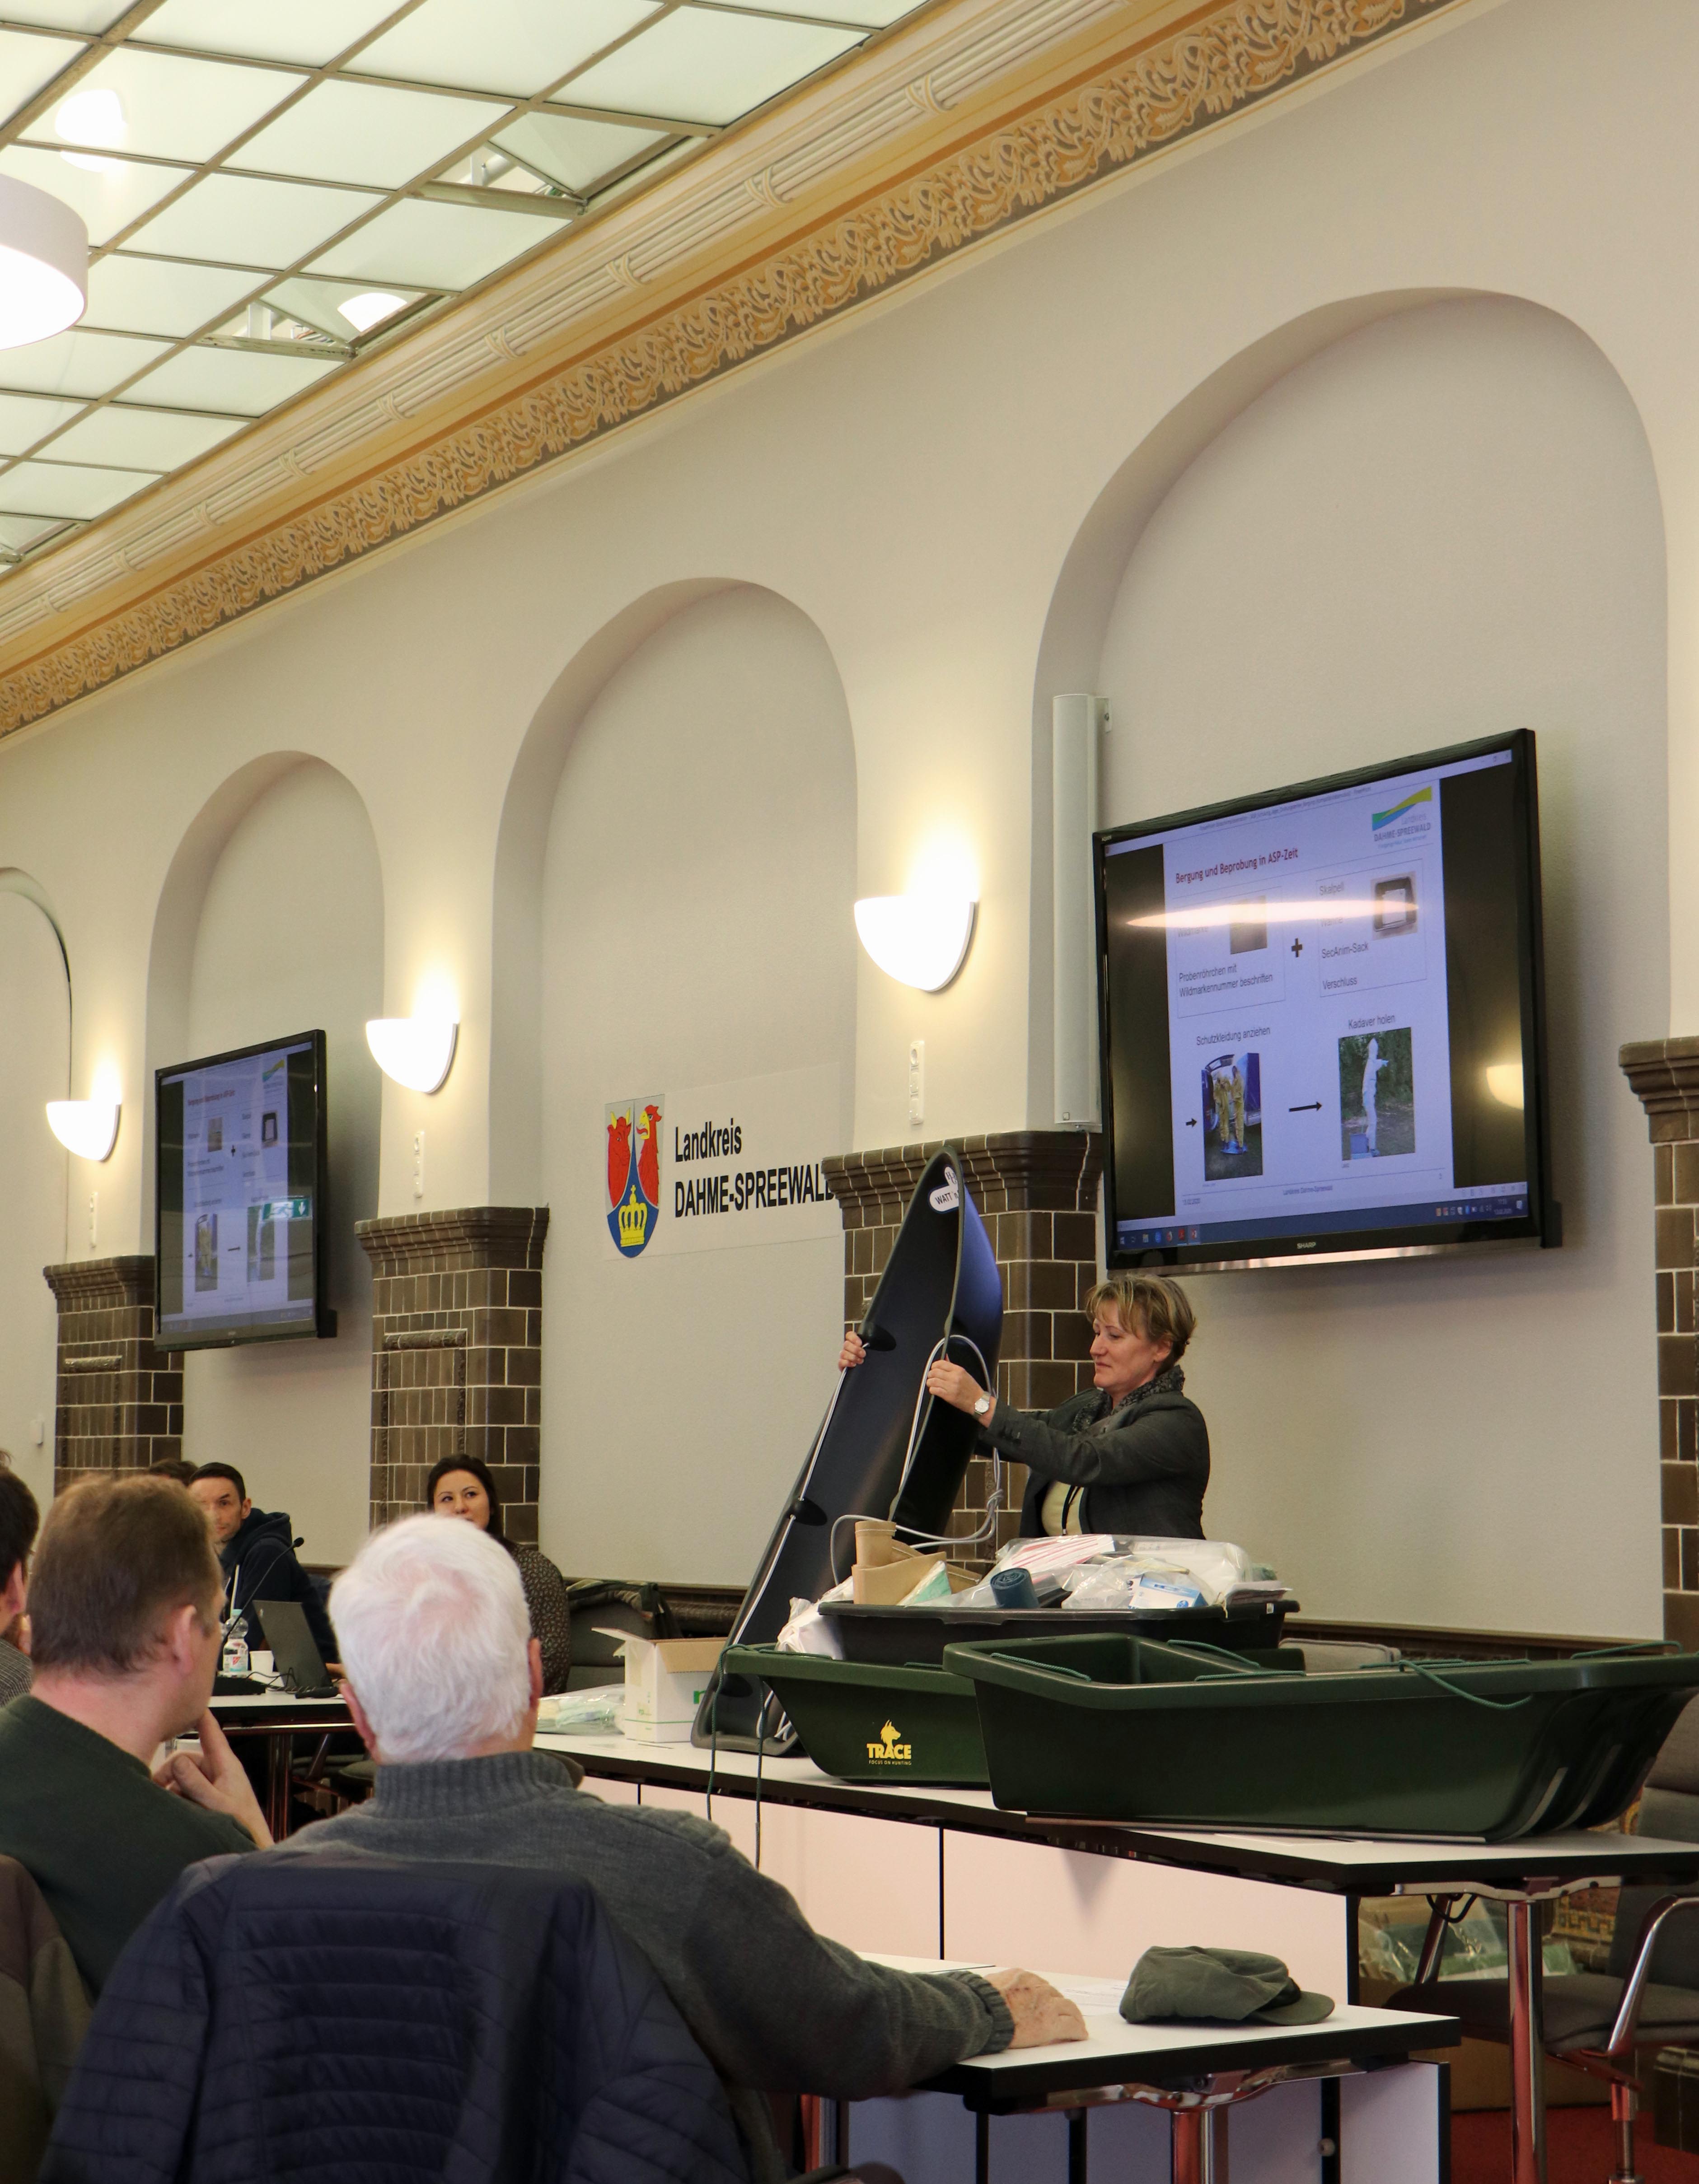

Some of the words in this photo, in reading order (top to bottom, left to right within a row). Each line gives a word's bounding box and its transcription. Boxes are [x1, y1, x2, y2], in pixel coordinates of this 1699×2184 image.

[1374, 822, 1431, 841] DAHME-SPREEWALD
[1176, 870, 1203, 883] Bergung
[1205, 864, 1218, 877] und
[1220, 859, 1258, 874] Beprobung
[1259, 855, 1266, 865] in
[1268, 848, 1298, 863] ASP-Zeit
[1319, 882, 1344, 896] Skalpell
[1322, 942, 1368, 959] SecAnim-Sack
[1179, 966, 1226, 982] Probenröhrchen
[1227, 963, 1237, 972] mit
[1179, 979, 1239, 997] Wildmarkennummer
[1240, 973, 1273, 987] beschriften
[1323, 977, 1357, 990] Verschluss
[1348, 1018, 1376, 1029] Kadaver
[1377, 1013, 1395, 1025] holen
[1196, 1031, 1241, 1046] Schutzkleidung
[1242, 1026, 1270, 1038] anziehen
[675, 1118, 742, 1162] Landkreis
[935, 1192, 952, 1205] WATT
[866, 1743, 912, 1759] TRACE
